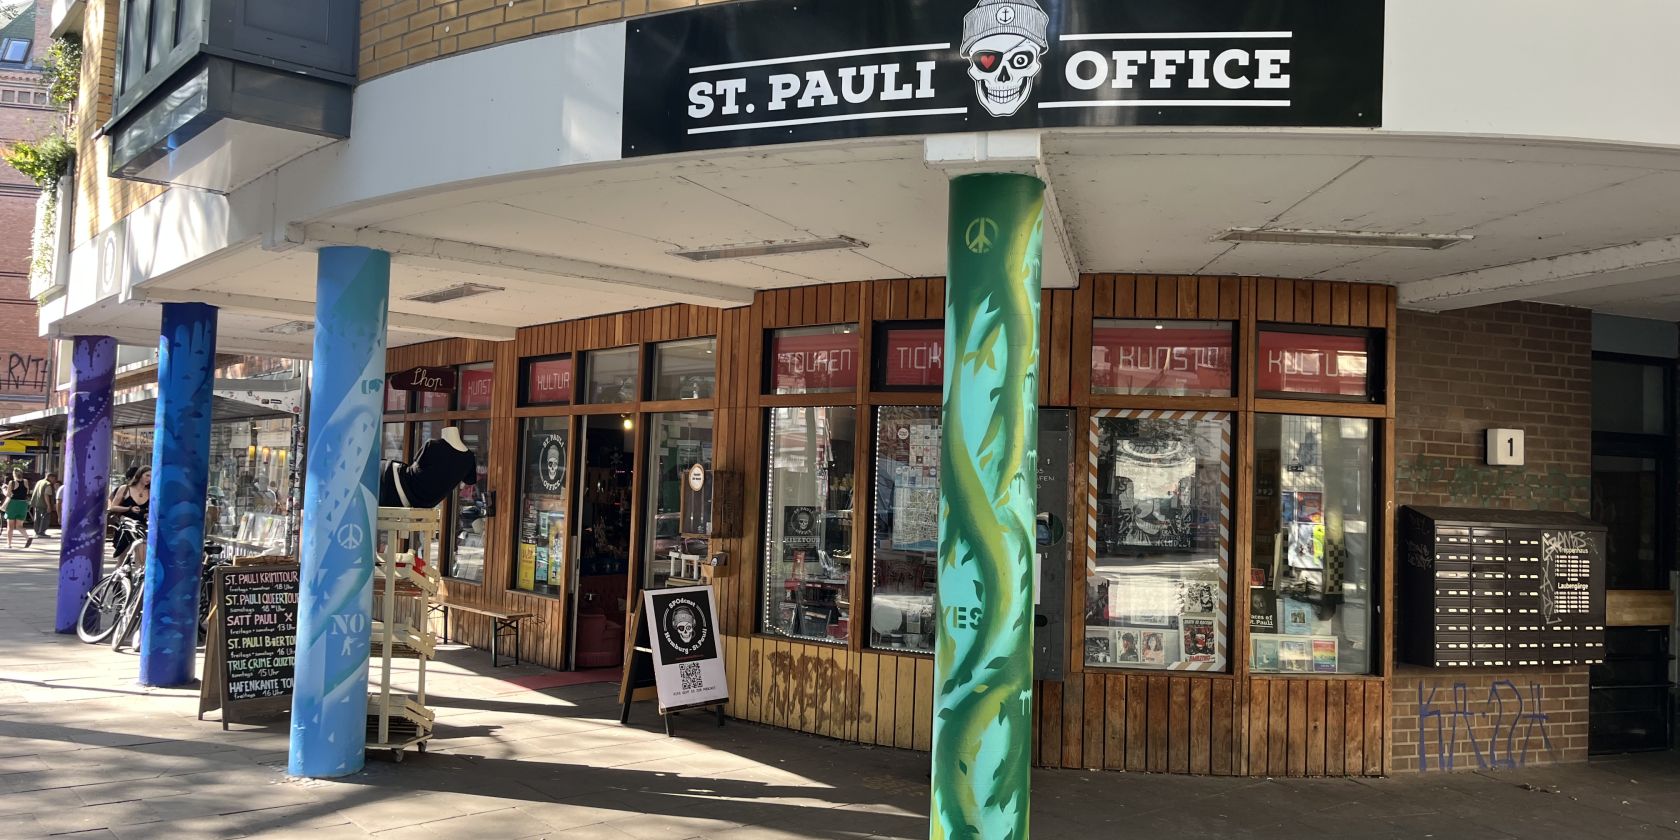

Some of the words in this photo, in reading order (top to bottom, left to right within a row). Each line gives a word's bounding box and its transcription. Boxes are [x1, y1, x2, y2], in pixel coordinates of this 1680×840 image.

[688, 77, 755, 118] ST.
[768, 61, 936, 111] PAULI
[1065, 48, 1290, 90] OFFICE
[787, 349, 851, 374] TOUREN
[468, 378, 492, 396] KUNST
[537, 371, 570, 391] KULTUR
[551, 434, 564, 447] PAULI
[1507, 437, 1514, 457] 1
[544, 480, 560, 490] OFFICE
[225, 574, 238, 586] ST.
[239, 573, 259, 585] PAULI
[260, 571, 299, 584] KRIMITOUR
[1557, 582, 1588, 591] Laubengänge
[225, 594, 240, 606] ST.
[240, 593, 261, 605] PAULI
[227, 614, 252, 626] SATT
[254, 613, 277, 625] PAULI
[330, 613, 365, 635] NO
[942, 606, 984, 630] YES
[227, 638, 241, 650] ST.
[242, 636, 263, 648] PAULI
[664, 631, 688, 655] Hamburg
[227, 660, 247, 675] TRUE
[248, 657, 272, 669] CRIME
[229, 679, 279, 693] HAFENKANTE
